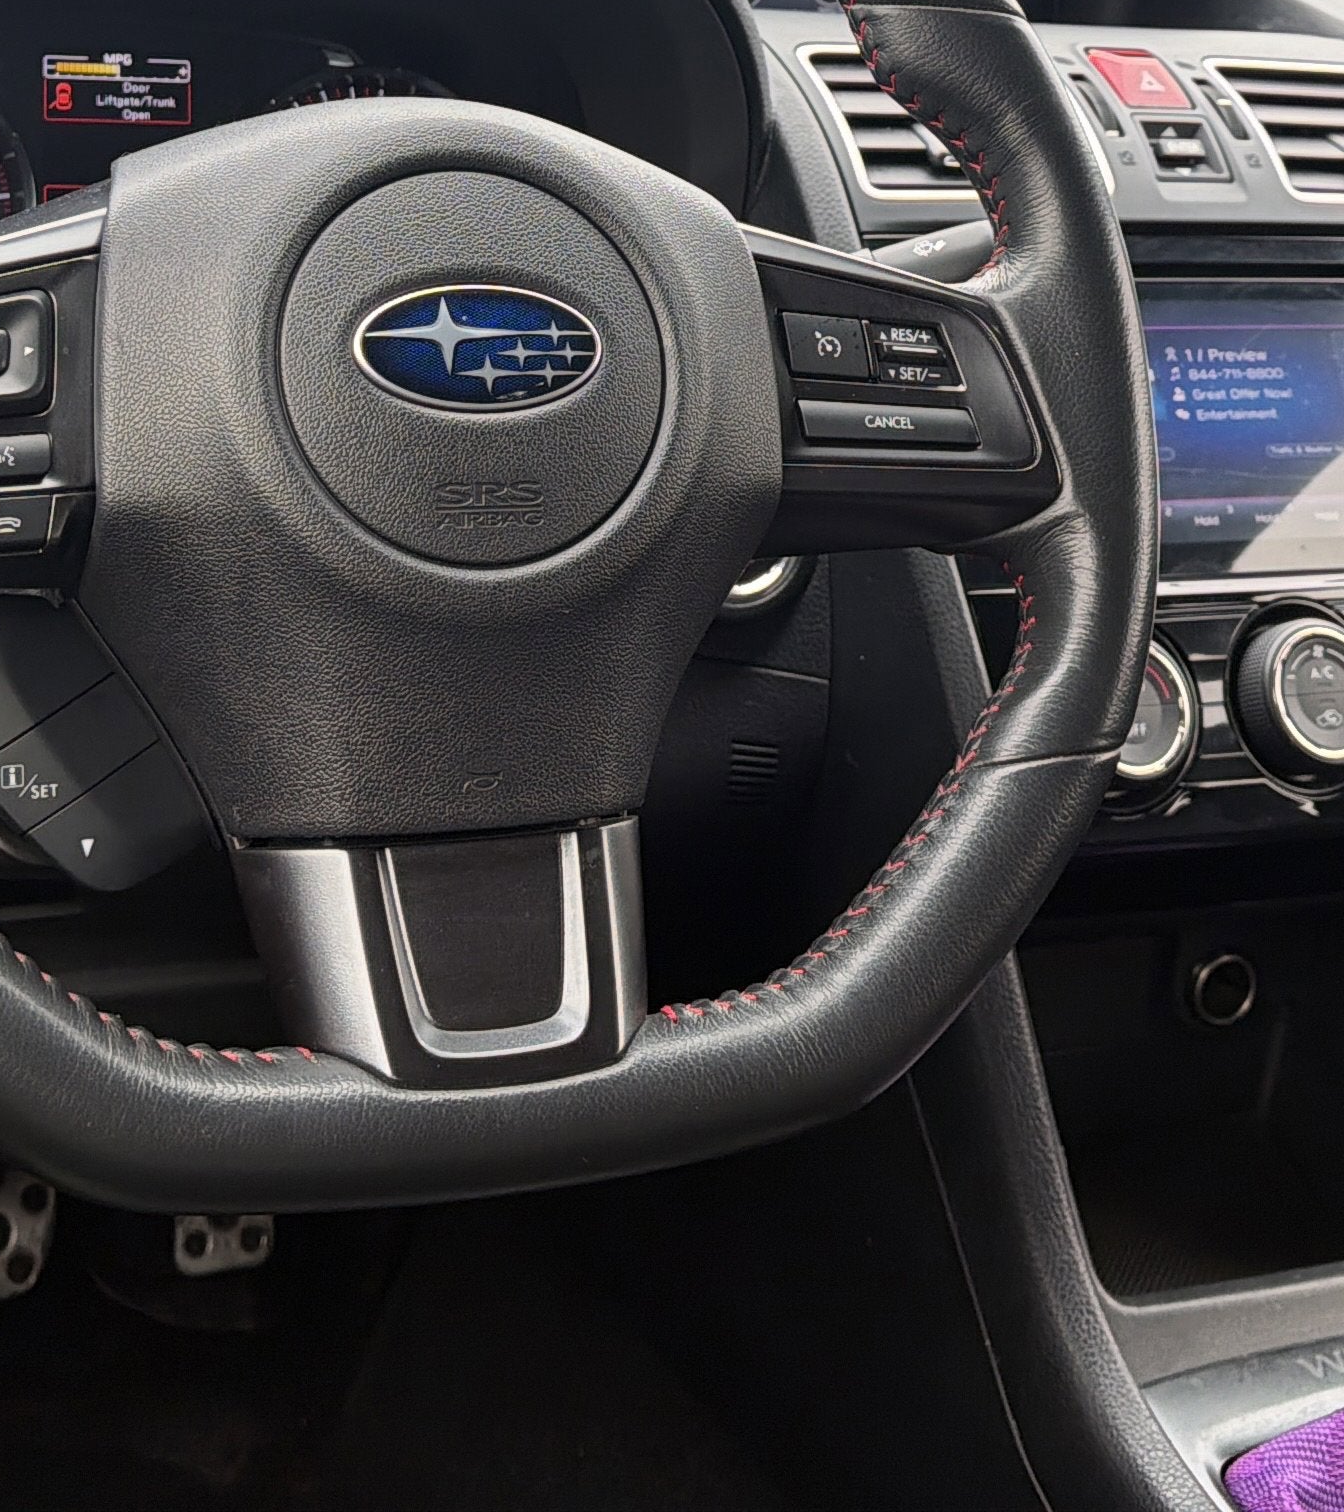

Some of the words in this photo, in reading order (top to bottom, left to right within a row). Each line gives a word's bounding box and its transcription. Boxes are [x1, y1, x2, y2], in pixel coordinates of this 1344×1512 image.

[102, 53, 133, 66] MPG
[121, 82, 151, 94] Door
[95, 95, 177, 109] Liftgate/Trunk
[121, 109, 151, 122] Open
[1207, 348, 1268, 362] Preview
[864, 414, 915, 430] CANCEL
[1196, 408, 1279, 422] Entertainment
[434, 480, 544, 508] SRS
[436, 512, 545, 531] AIRBAG
